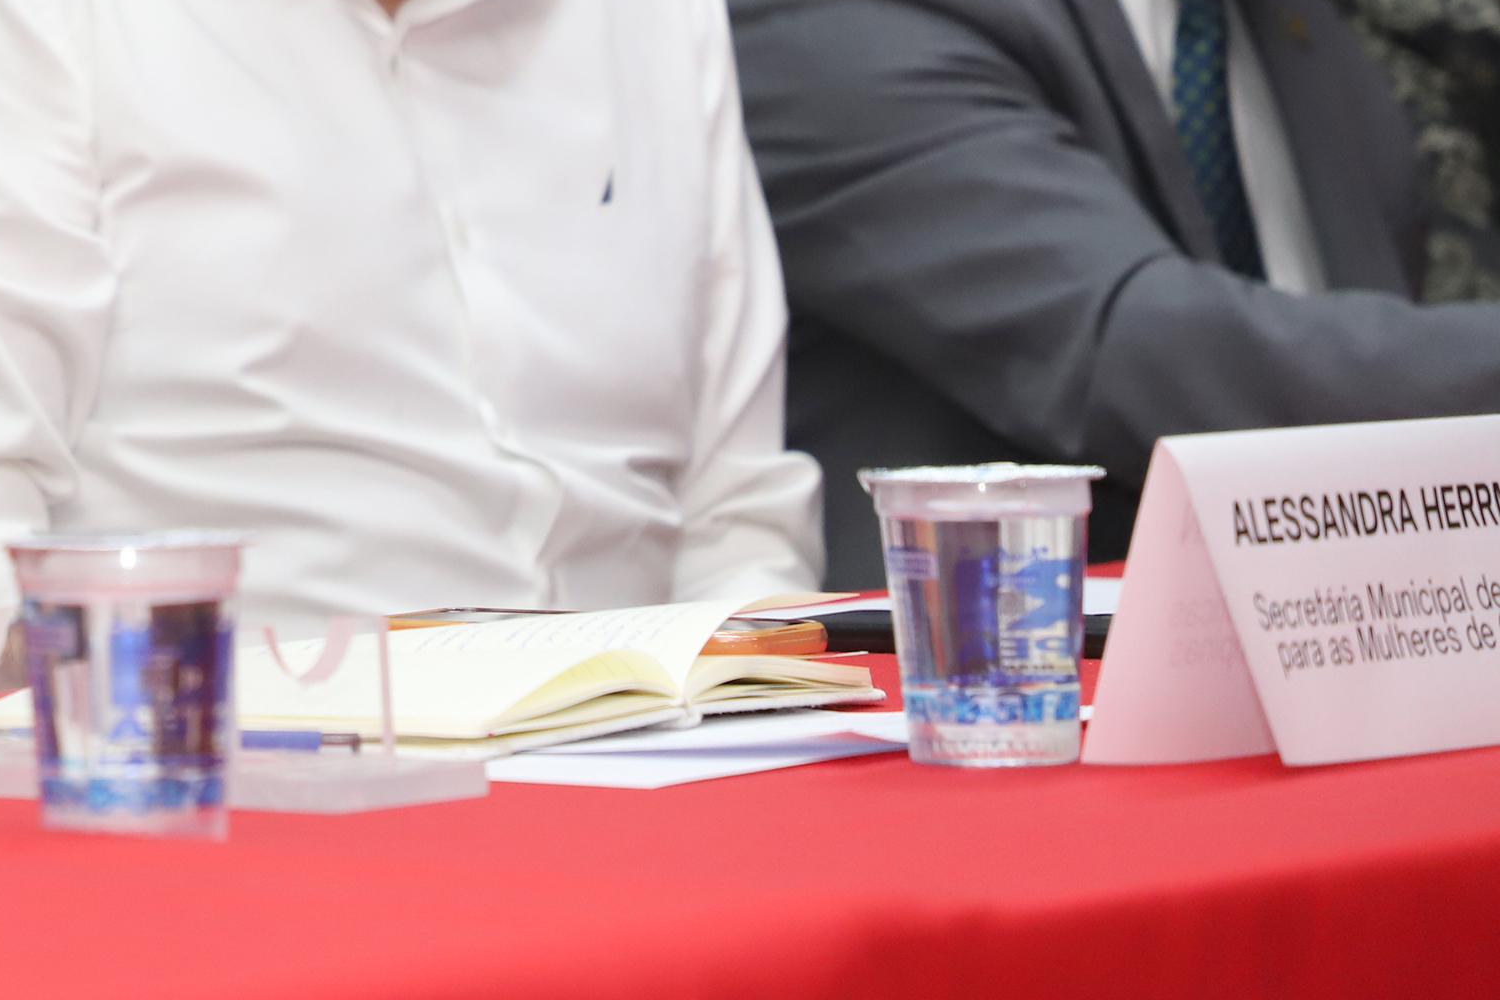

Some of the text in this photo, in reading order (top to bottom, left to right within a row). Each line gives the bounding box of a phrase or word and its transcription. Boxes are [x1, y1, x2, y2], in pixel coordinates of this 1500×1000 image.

[1232, 488, 1418, 546] ALESSANDRA
[1252, 585, 1363, 631] Secretária
[1366, 577, 1473, 621] Municipal
[1277, 638, 1324, 679] para
[1329, 636, 1355, 667] as
[1356, 621, 1462, 662] Mulheres
[1466, 614, 1498, 651] de
